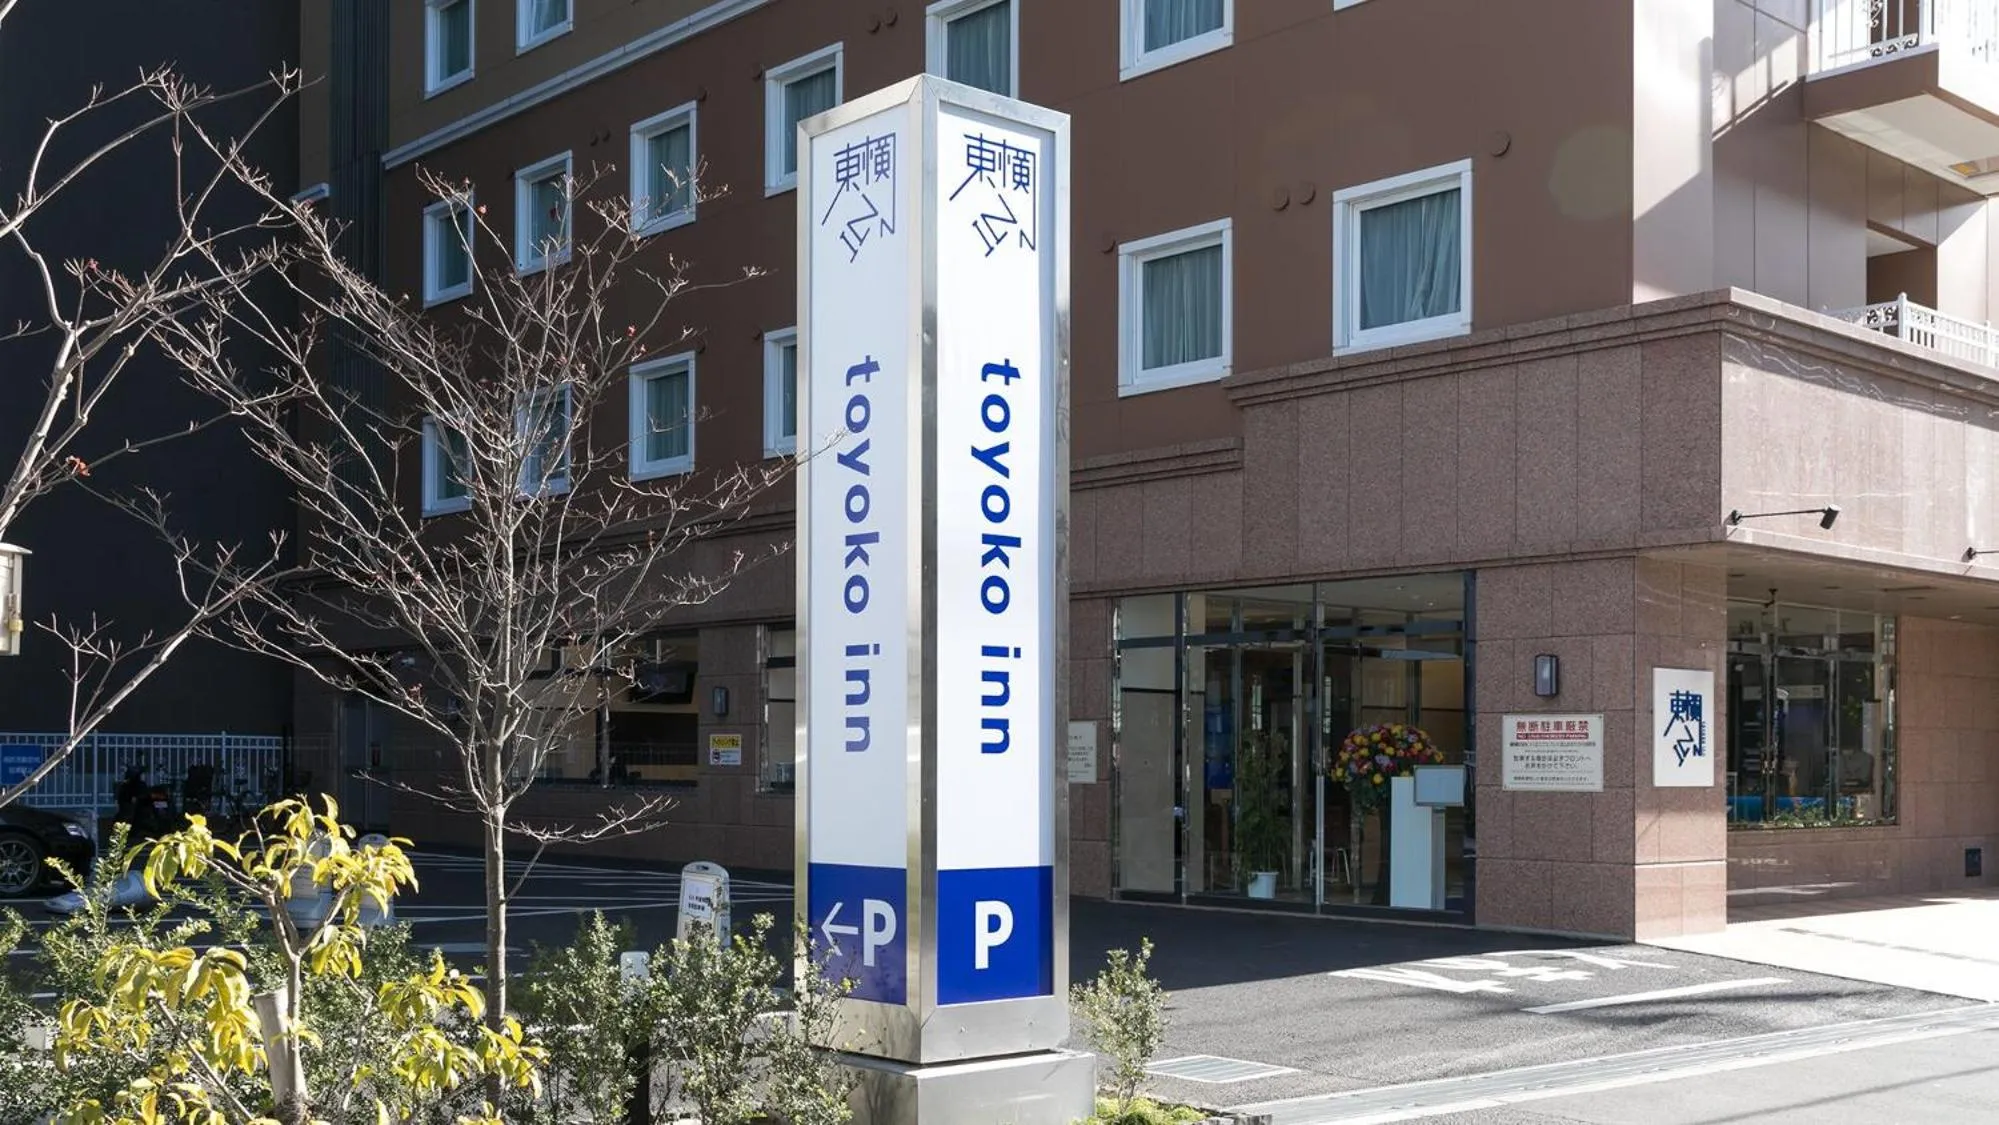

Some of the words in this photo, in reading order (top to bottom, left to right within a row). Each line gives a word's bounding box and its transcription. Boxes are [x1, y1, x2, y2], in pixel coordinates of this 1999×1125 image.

[836, 355, 881, 615] toyoko
[970, 358, 1022, 615] toyoko
[844, 643, 881, 753] inn
[980, 645, 1022, 754] inn
[862, 898, 898, 967] P
[975, 900, 1014, 970] P
